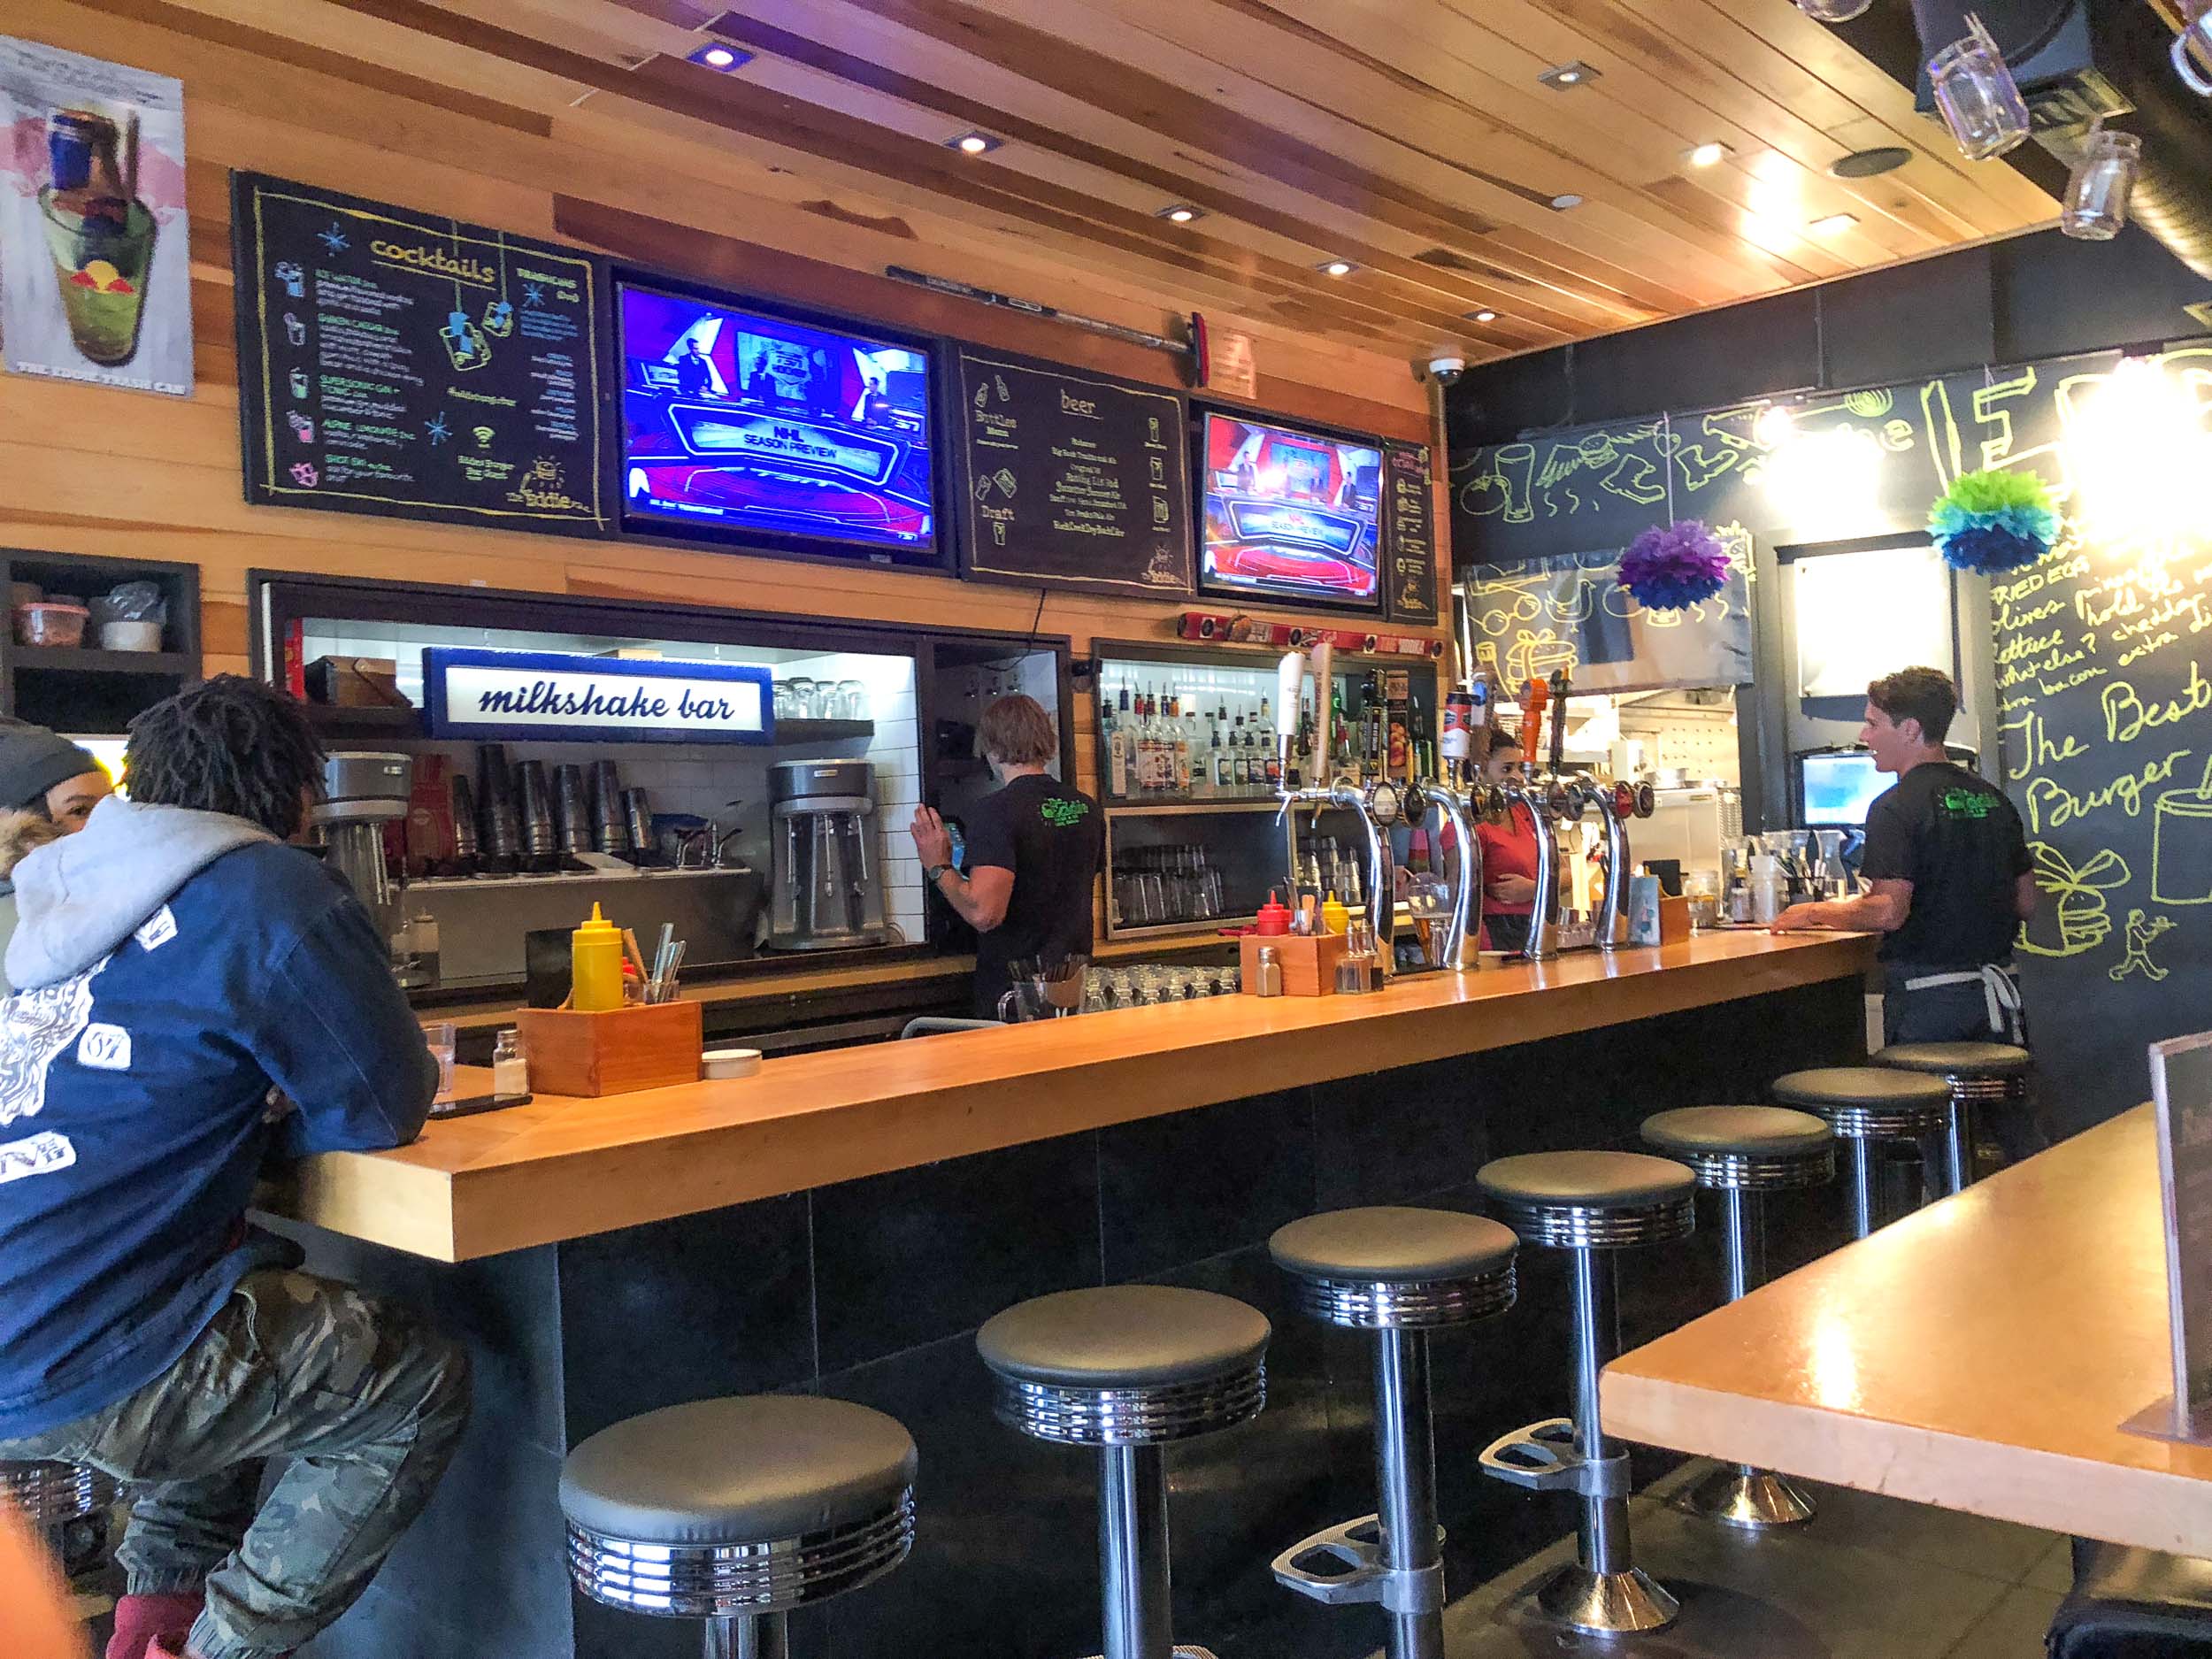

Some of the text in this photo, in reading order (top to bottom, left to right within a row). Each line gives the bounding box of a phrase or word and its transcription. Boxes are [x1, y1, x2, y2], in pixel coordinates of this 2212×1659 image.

[370, 240, 495, 284] cocktails
[743, 434, 837, 458] SEASON PREVIEW
[773, 426, 805, 443] NHL
[479, 680, 735, 720] milkshake bar
[1996, 659, 2212, 780] The Best
[2025, 749, 2193, 834] Burger
